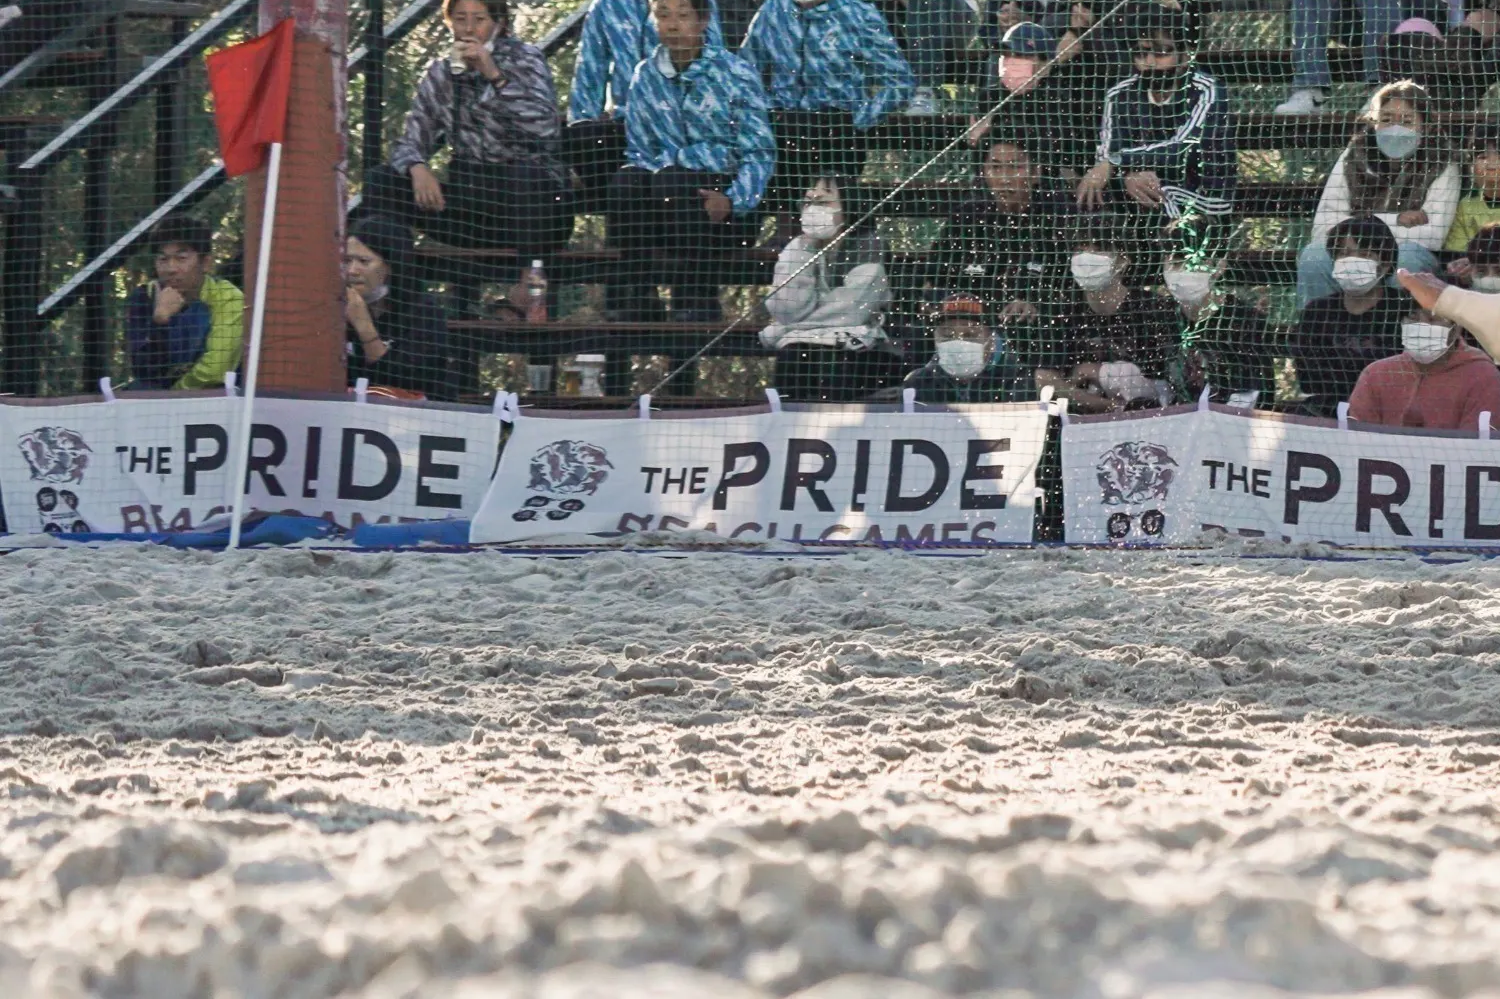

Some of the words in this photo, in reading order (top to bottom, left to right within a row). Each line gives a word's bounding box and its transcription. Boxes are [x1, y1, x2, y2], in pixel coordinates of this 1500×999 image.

[116, 446, 172, 475] THE
[640, 466, 709, 495] THE
[1201, 459, 1271, 499] THE
